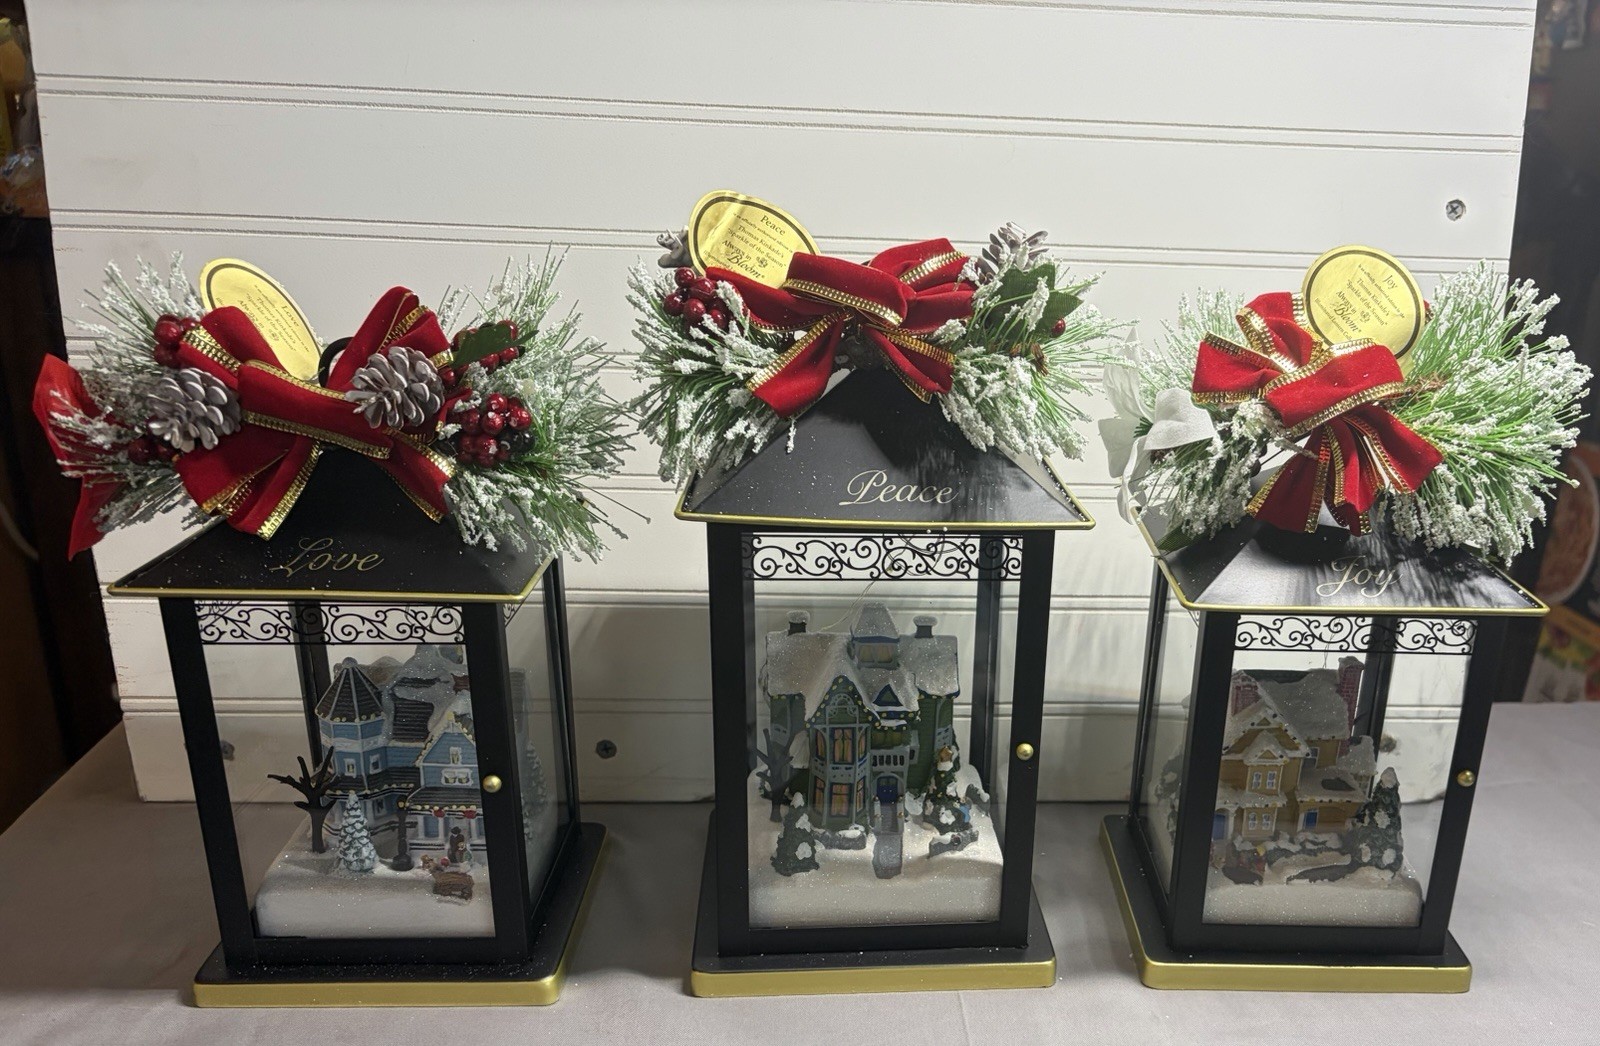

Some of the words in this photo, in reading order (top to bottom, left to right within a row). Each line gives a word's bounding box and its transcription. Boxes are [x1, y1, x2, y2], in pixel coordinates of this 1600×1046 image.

[760, 215, 786, 236] Peace
[722, 240, 745, 257] Always
[737, 226, 759, 241] Thomas
[759, 239, 784, 257] Kinkade's
[755, 246, 765, 254] the
[1383, 275, 1398, 290] Joy
[257, 297, 275, 318] Thomas
[1335, 291, 1353, 310] Always
[1357, 278, 1372, 297] Thomas
[1371, 294, 1389, 316] Kinkade's
[1363, 299, 1372, 310] the
[239, 300, 259, 323] Always
[281, 305, 299, 327] Love
[269, 320, 279, 331] the
[839, 469, 959, 505] Peace
[269, 538, 385, 577] Love
[1316, 555, 1403, 597] Joy
